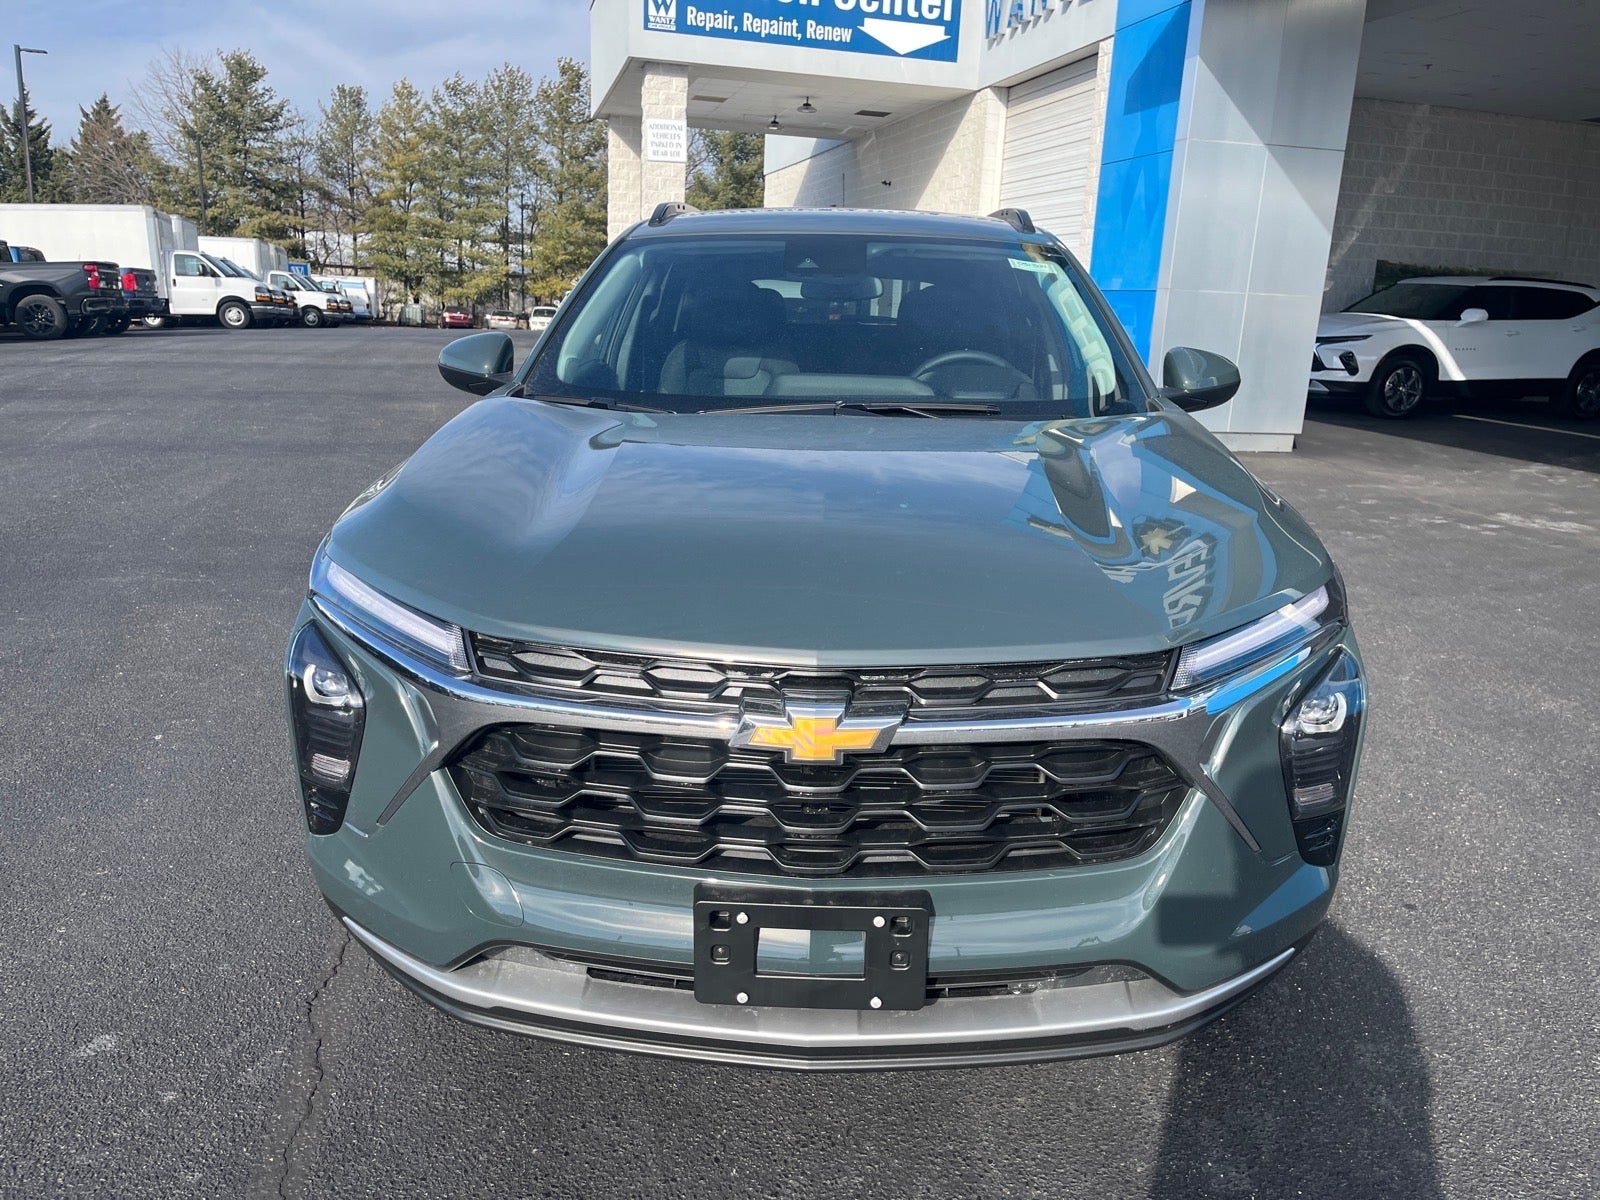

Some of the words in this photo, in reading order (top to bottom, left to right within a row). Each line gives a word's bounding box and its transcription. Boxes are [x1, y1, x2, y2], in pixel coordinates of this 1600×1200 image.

[648, 16, 676, 24] WANTZ
[686, 6, 738, 32] Repair,
[743, 13, 801, 40] Repaint,
[806, 20, 853, 43] Renew
[652, 132, 681, 140] VEHICLES
[652, 149, 668, 157] REAR
[669, 150, 680, 158] LOT
